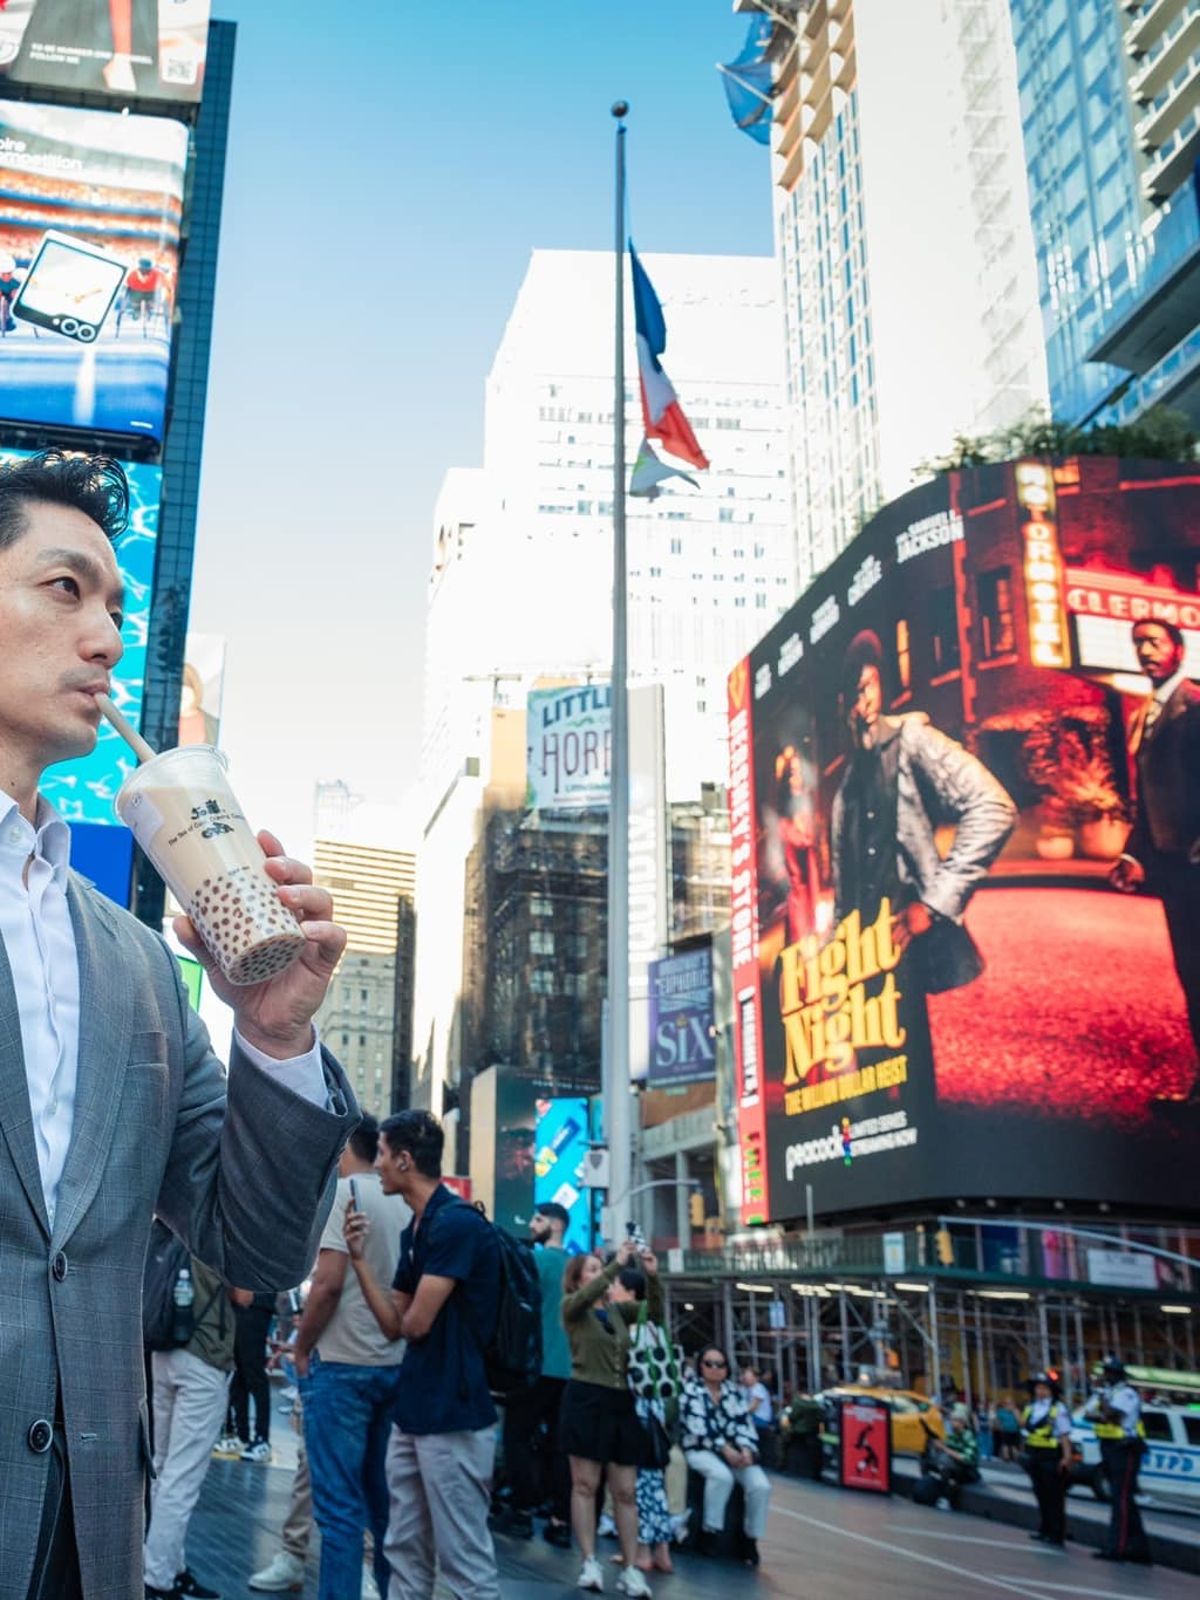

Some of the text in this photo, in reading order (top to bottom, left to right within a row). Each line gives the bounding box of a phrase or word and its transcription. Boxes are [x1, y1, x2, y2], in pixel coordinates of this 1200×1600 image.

[780, 896, 901, 1014] Fight
[783, 972, 906, 1086] Night
[785, 1125, 844, 1181] peacock
